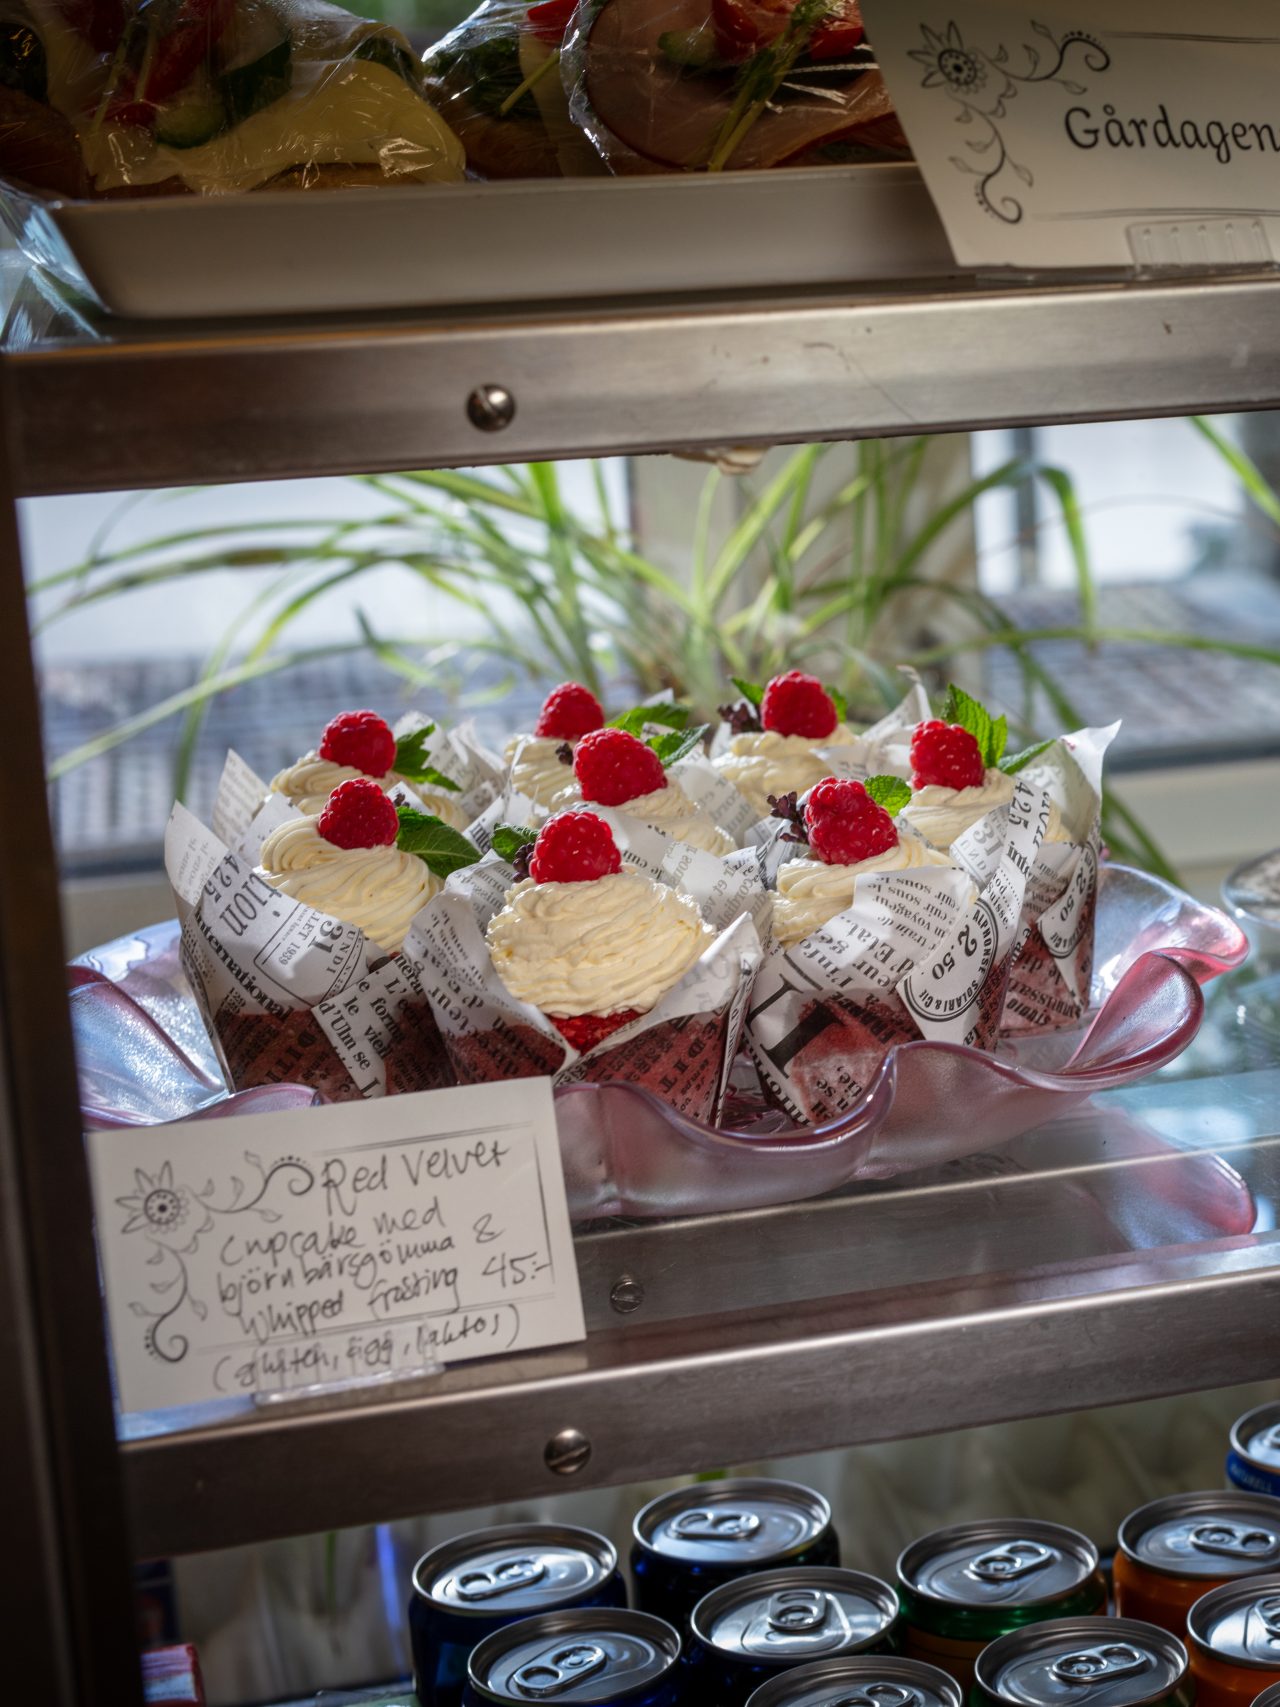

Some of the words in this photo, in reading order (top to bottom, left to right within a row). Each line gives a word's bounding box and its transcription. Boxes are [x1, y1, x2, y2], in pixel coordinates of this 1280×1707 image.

[320, 1158, 389, 1217] Red
[403, 1142, 510, 1188] Velvet
[374, 1200, 446, 1236] med
